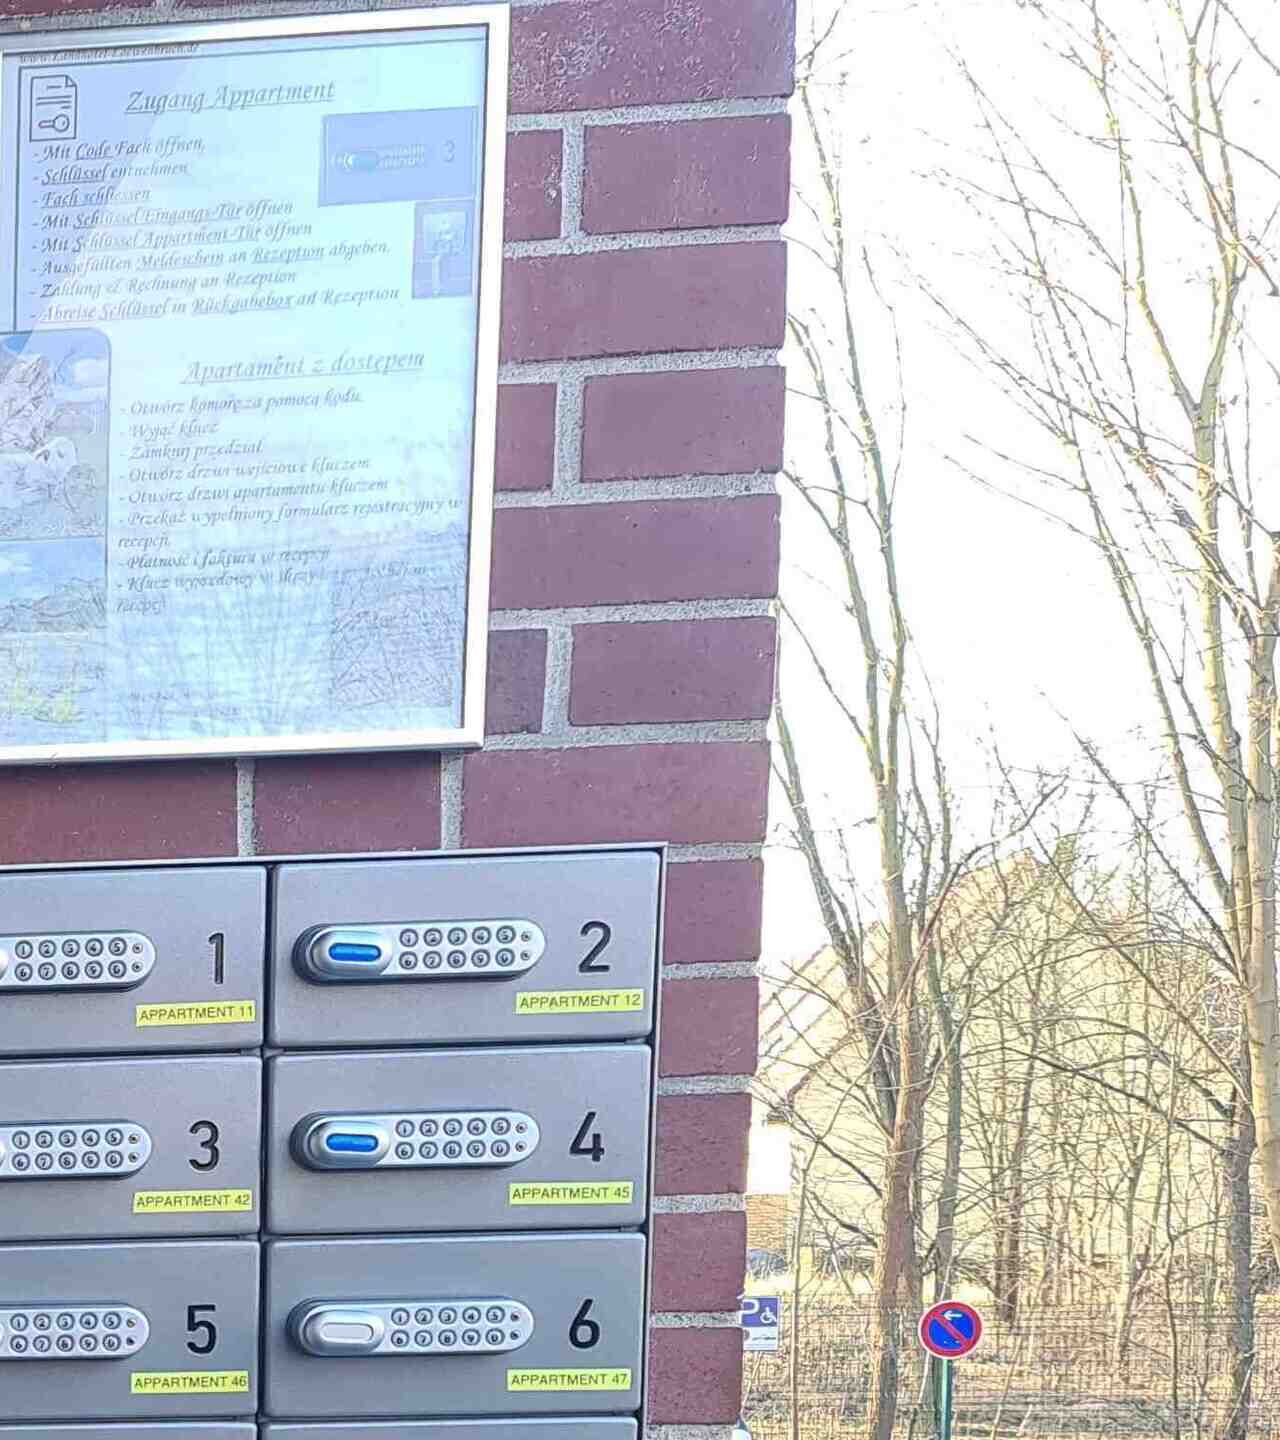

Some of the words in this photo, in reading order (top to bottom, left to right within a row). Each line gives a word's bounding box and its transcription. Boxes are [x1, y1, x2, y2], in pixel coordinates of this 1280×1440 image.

[125, 89, 205, 114] Zugang
[213, 81, 335, 109] Appartment
[209, 932, 225, 984] 1
[579, 922, 610, 972] 2
[140, 1007, 234, 1022] APPARTMENT
[240, 1006, 254, 1018] 11
[520, 995, 618, 1008] APPARTMENT
[624, 994, 640, 1006] 12
[189, 1120, 220, 1171] 3
[569, 1111, 605, 1161] 4
[138, 1195, 230, 1208] APPARTMENT
[234, 1194, 250, 1206] 42
[513, 1186, 610, 1200] APPARTMENT
[614, 1188, 630, 1198] 45
[185, 1305, 218, 1354] 5
[569, 1299, 600, 1349] 6
[136, 1376, 229, 1388] APPARTMENT
[232, 1376, 247, 1388] 46
[512, 1374, 608, 1386] APPARTMENT
[612, 1374, 628, 1385] 47
